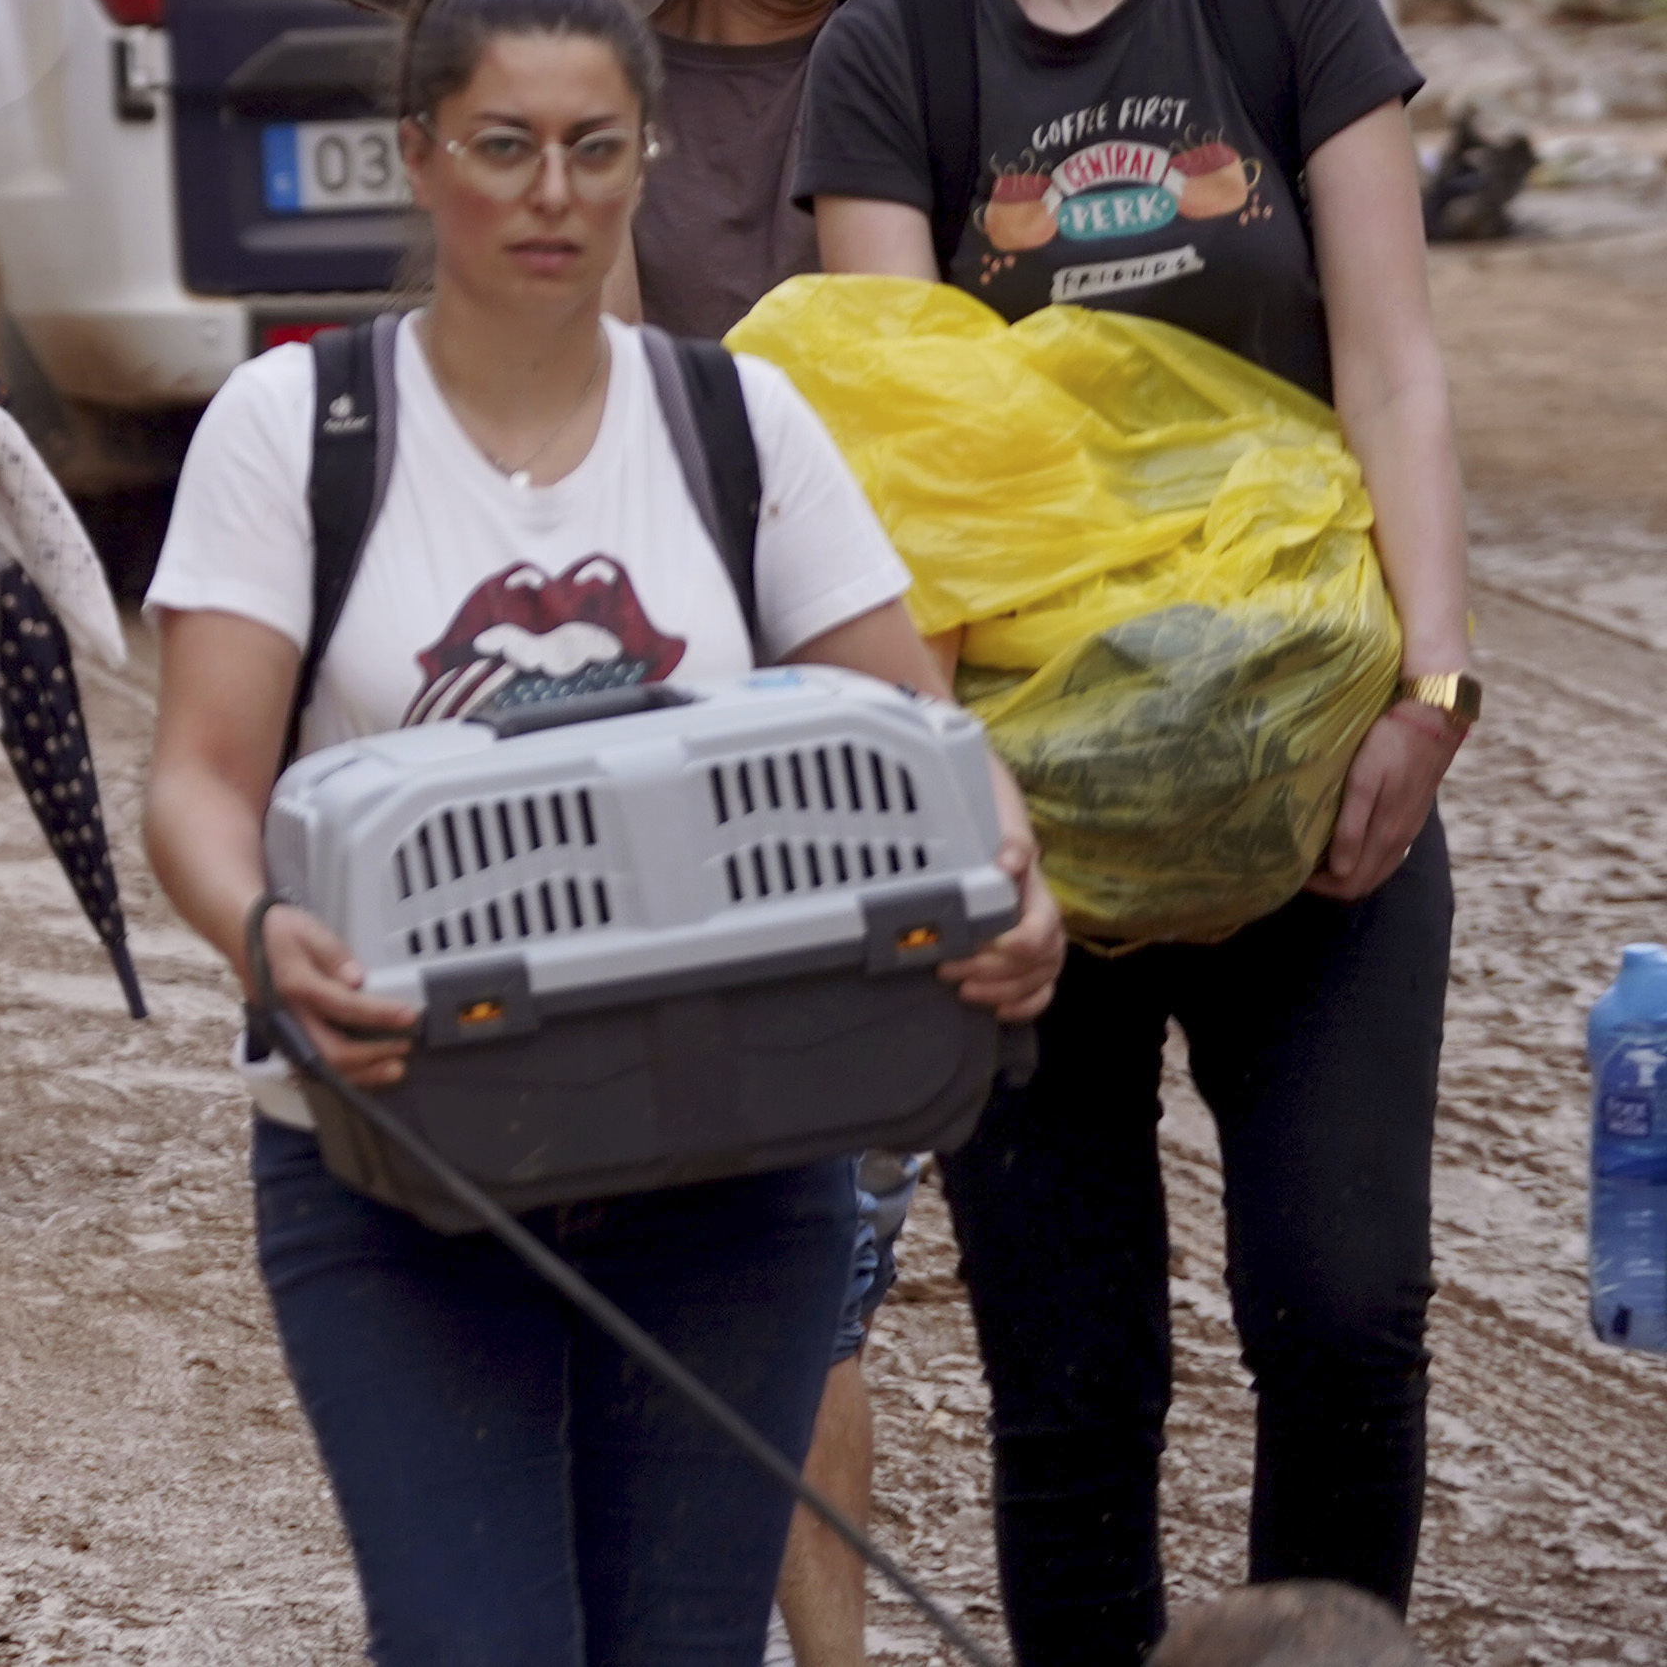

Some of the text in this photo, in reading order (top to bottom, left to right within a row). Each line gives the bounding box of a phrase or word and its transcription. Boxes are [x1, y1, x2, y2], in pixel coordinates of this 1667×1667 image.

[1032, 95, 1190, 152] COFFEE FIRST
[1063, 144, 1155, 190] CENTRAL
